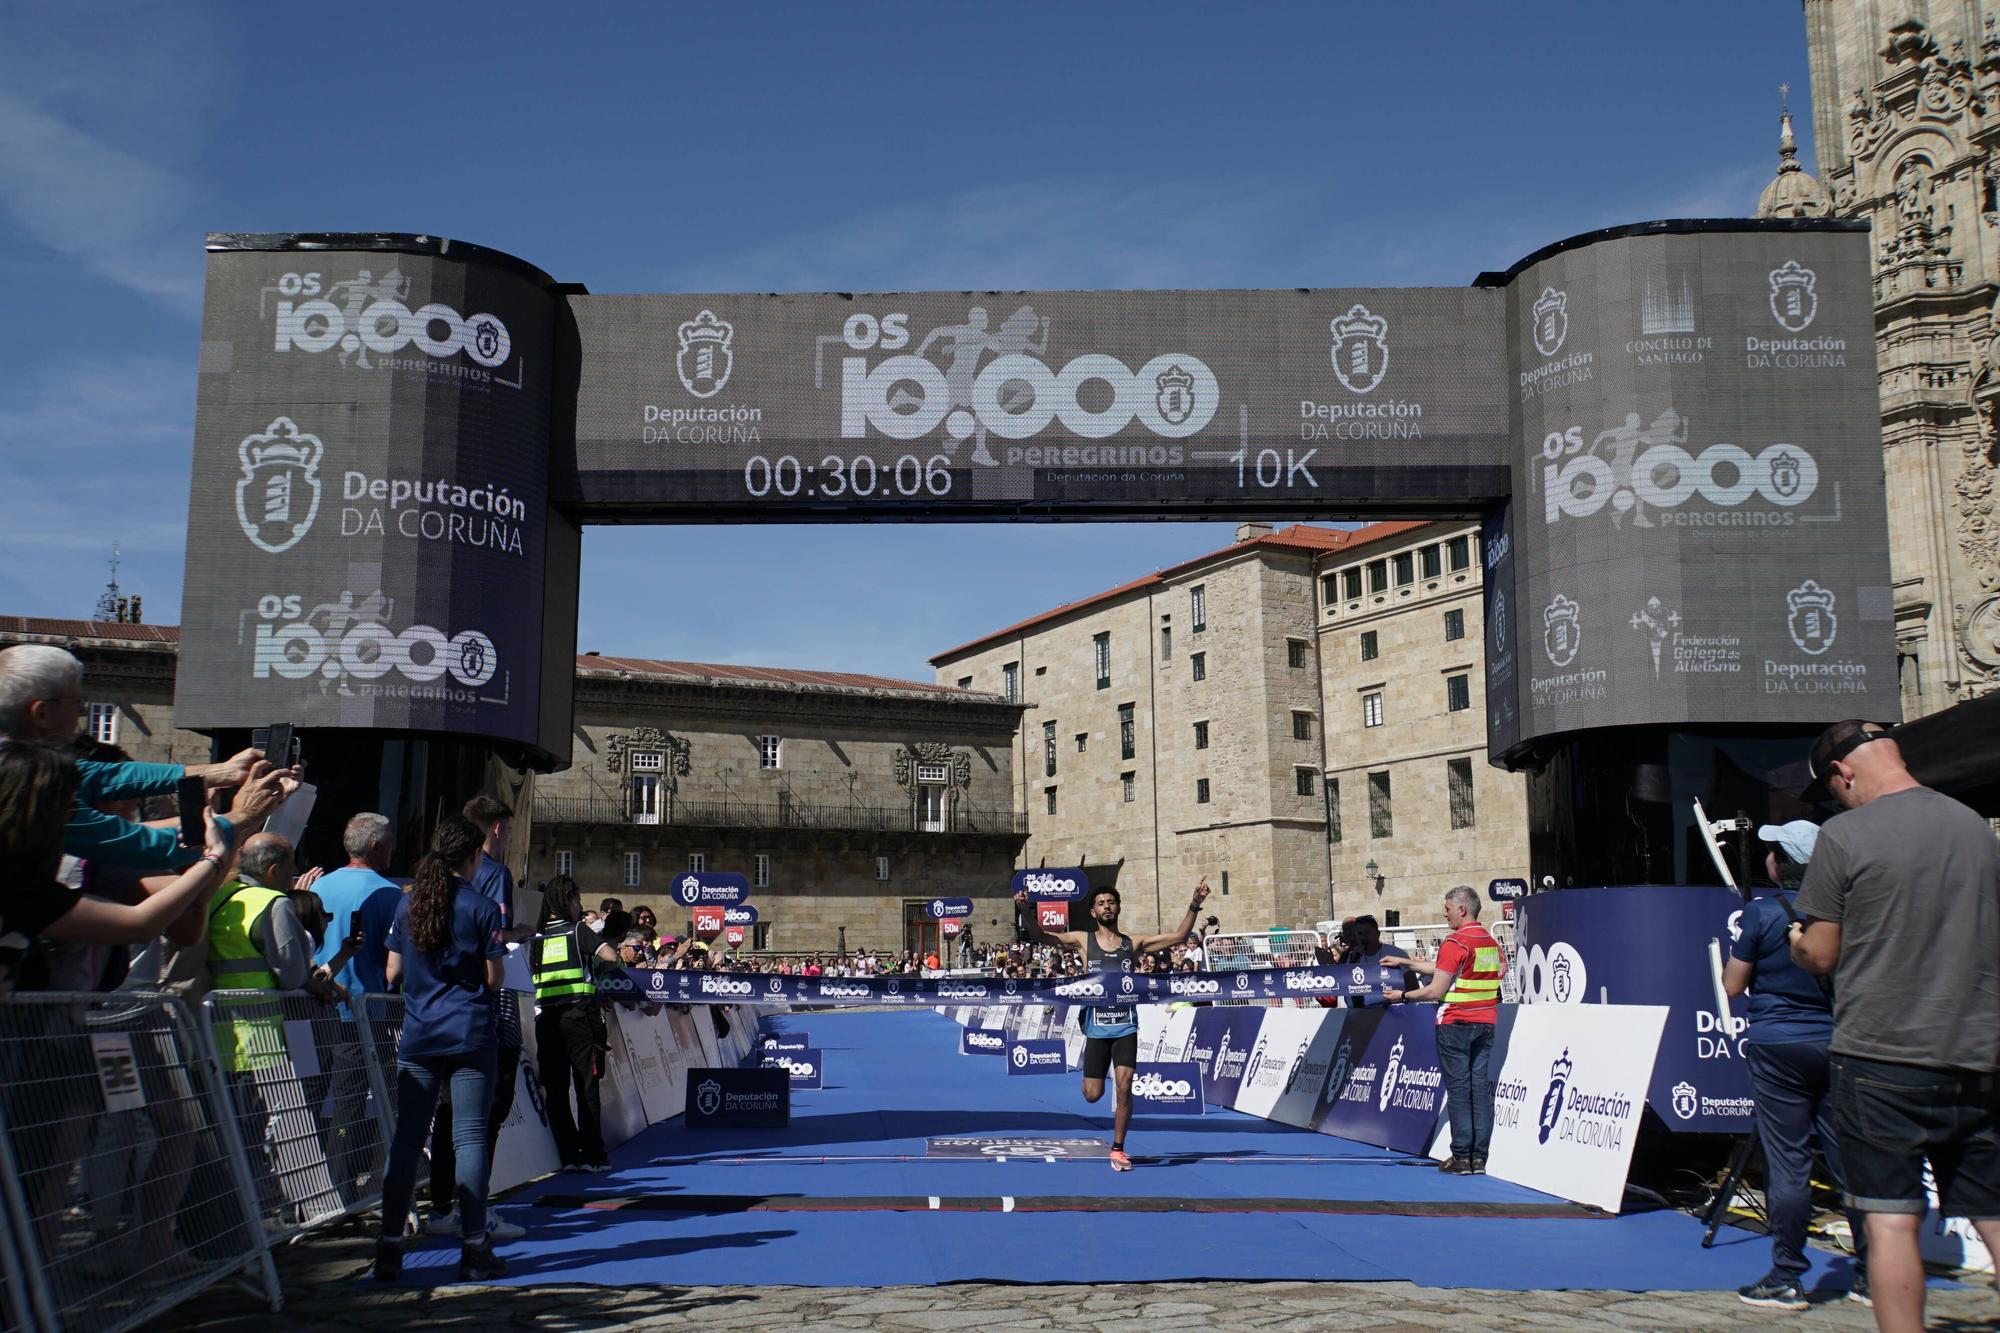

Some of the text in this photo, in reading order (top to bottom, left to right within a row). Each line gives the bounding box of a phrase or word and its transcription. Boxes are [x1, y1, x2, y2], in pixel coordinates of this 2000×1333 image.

[1626, 337, 1712, 352] CONCELLO DE
[1747, 336, 1846, 355] Deputación
[1639, 352, 1703, 366] SANTIAGO
[1747, 351, 1846, 368] DA CORUÑA
[1521, 352, 1593, 387] Deputación
[1521, 367, 1593, 403] DA CORUÑA
[644, 405, 762, 427] Deputación
[1301, 400, 1422, 423] Deputación
[643, 423, 761, 444] DA CORUÑA
[1301, 419, 1422, 440] DA CORUÑA
[744, 454, 952, 496] 00:30:06
[1047, 471, 1117, 483] Deputación
[1122, 473, 1136, 482] da
[1230, 449, 1319, 488] 10K
[344, 471, 525, 521] Deputación
[341, 507, 523, 556] DA CORUÑA
[1673, 632, 1740, 646] Federación
[1674, 647, 1726, 661] Galega
[1674, 660, 1741, 673] Atletismo
[1765, 660, 1867, 680] Deputación
[1531, 667, 1607, 693] Deputación
[1765, 677, 1867, 694] DA CORUÑA
[1548, 683, 1607, 705] CORUÑA
[702, 885, 739, 894] Deputación
[712, 892, 739, 900] CORUÑA
[697, 915, 720, 930] 25M
[1042, 910, 1065, 926] 25M
[1030, 1052, 1061, 1060] Deputación
[1697, 1037, 1731, 1059] DA
[1399, 1064, 1442, 1089] Deputación
[726, 1092, 779, 1102] Deputación
[740, 1101, 778, 1110] CORUÑA
[1392, 1088, 1435, 1111] DA CORUÑA
[1567, 1087, 1631, 1119] Deputación
[1702, 1096, 1755, 1108] Deputación
[1702, 1107, 1717, 1116] DA
[1560, 1117, 1622, 1151] DA CORUÑA
